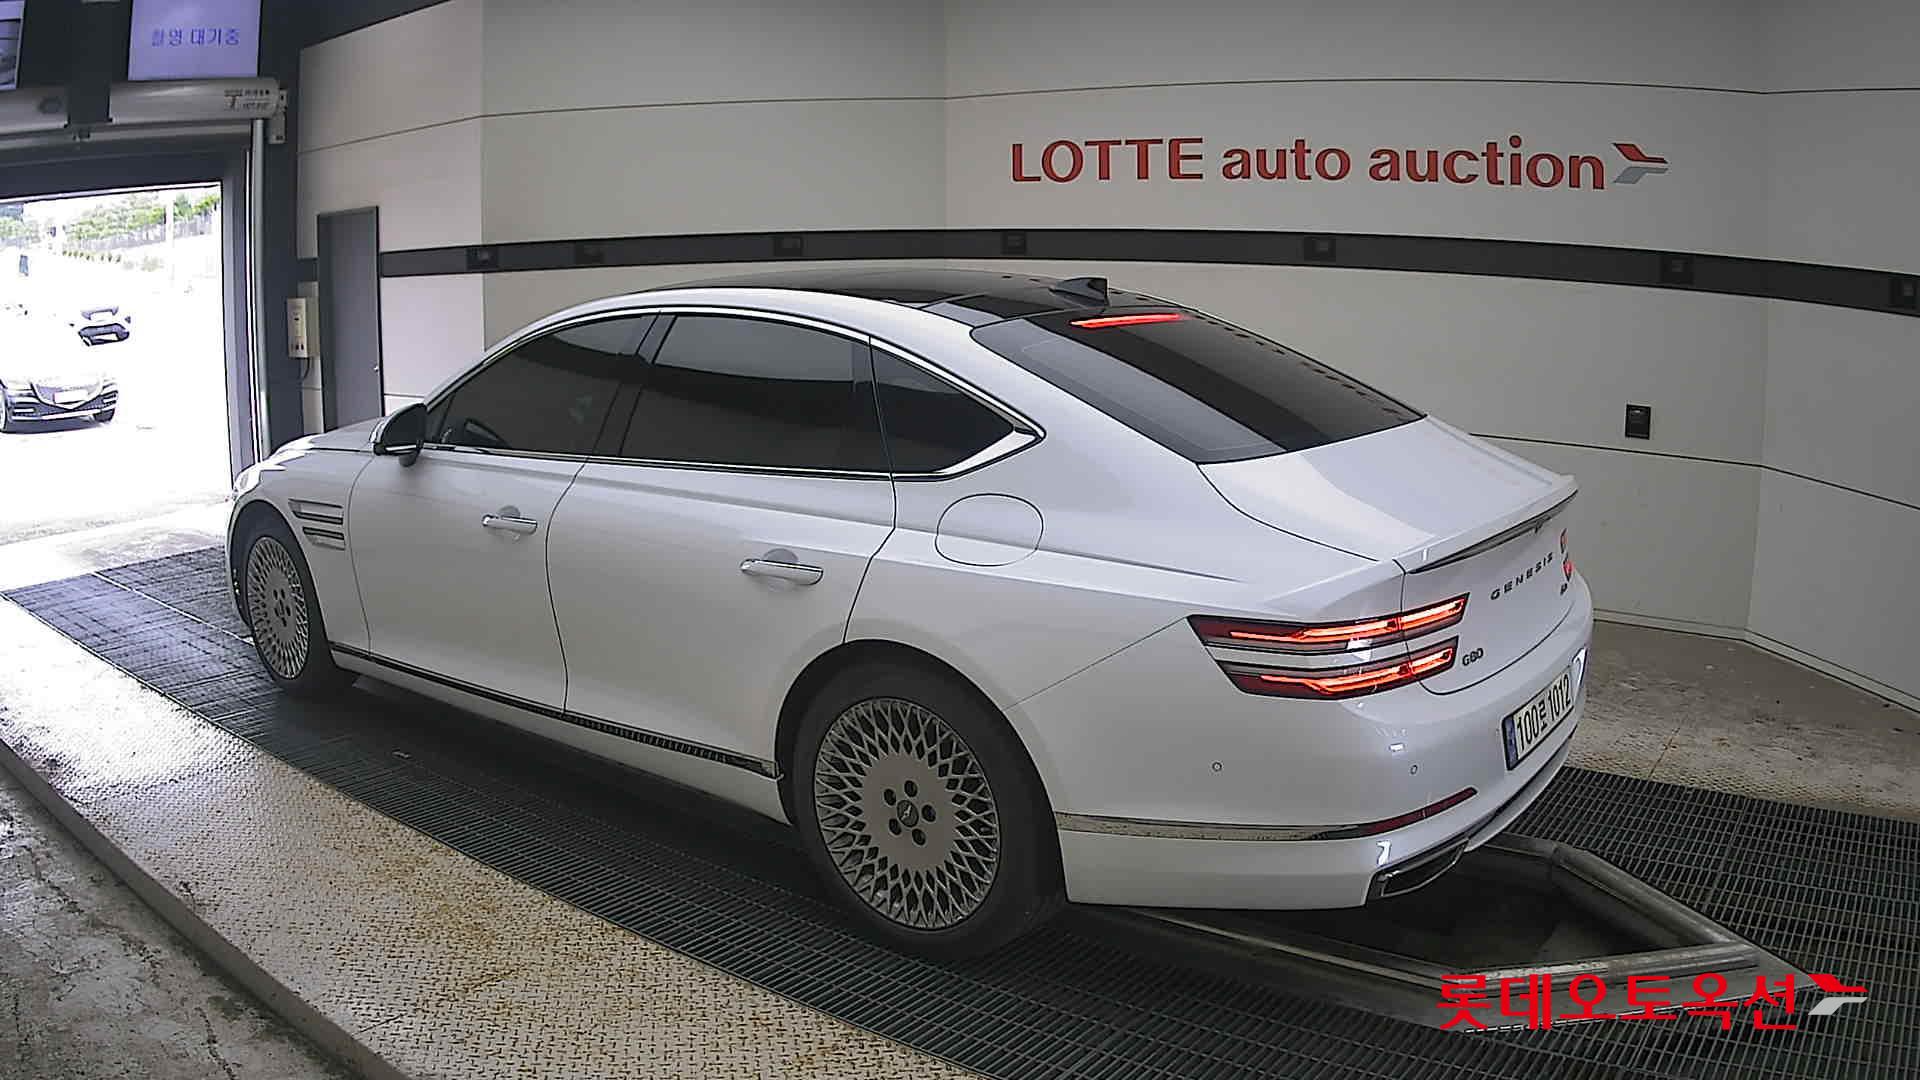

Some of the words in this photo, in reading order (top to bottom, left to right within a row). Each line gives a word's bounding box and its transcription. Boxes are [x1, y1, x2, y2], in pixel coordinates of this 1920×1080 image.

[190, 26, 241, 47] 대기중
[1010, 138, 1203, 183] LOTTE
[1221, 139, 1351, 181] auto
[1368, 135, 1605, 190] auction
[1490, 552, 1553, 600] GENESIS
[1462, 647, 1484, 667] G80
